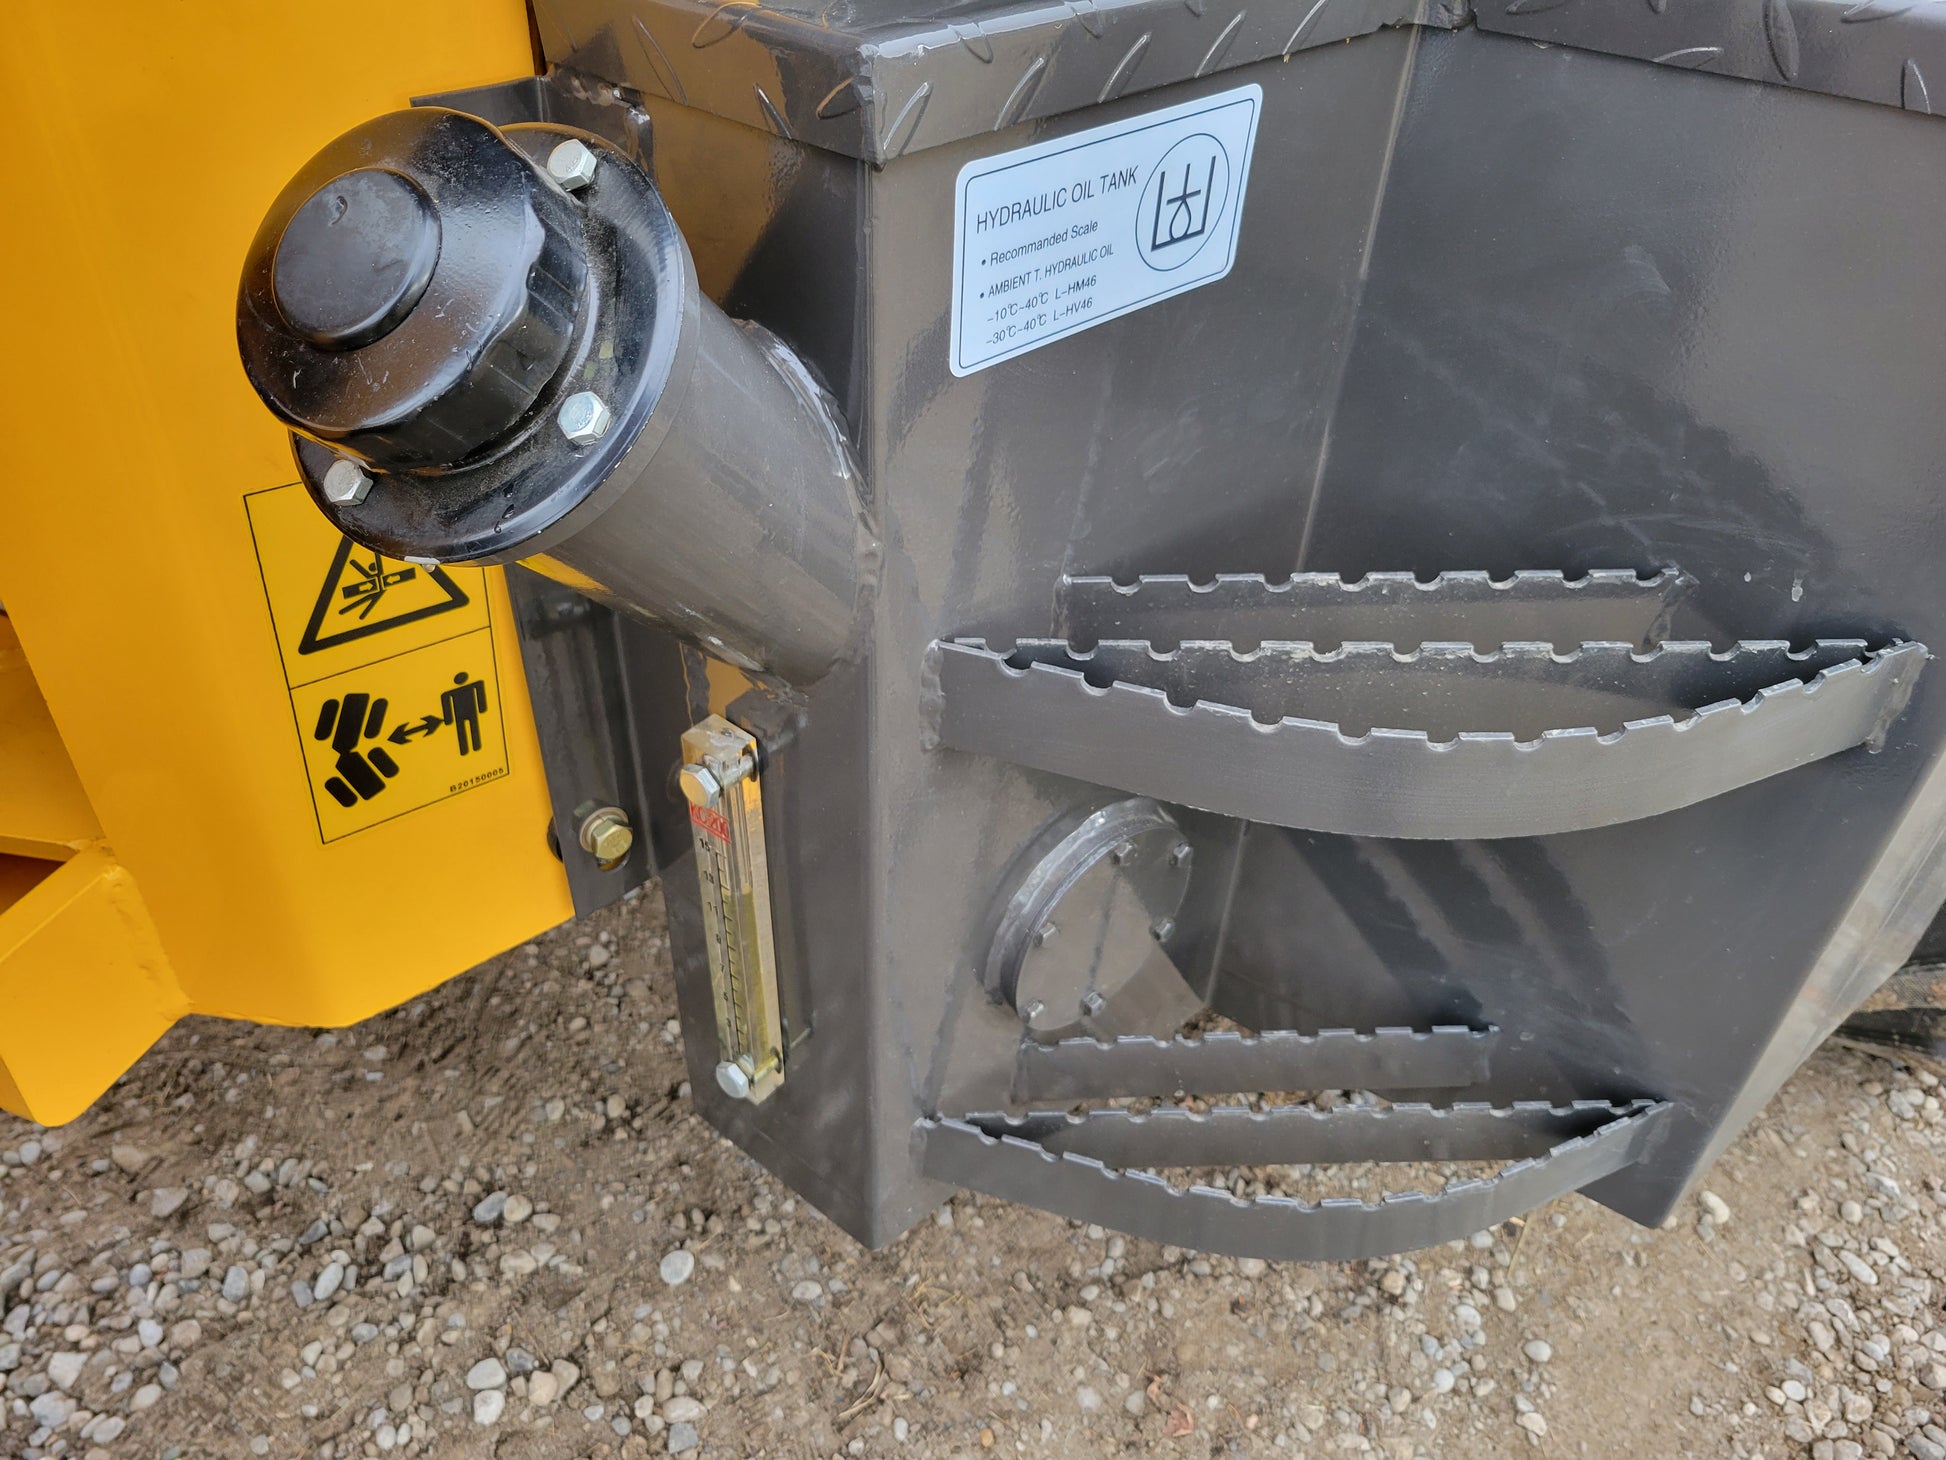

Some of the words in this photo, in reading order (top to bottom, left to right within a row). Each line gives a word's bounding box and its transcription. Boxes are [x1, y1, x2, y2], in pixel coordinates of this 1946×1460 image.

[977, 187, 1067, 233] HYDRAULIC
[1071, 180, 1095, 203] OIL
[1100, 165, 1139, 195] TANK
[990, 229, 1068, 266] Recommanded
[1071, 220, 1098, 239] Scale
[988, 271, 1032, 298] AMBIENT
[1035, 268, 1042, 282] T.
[1044, 248, 1098, 279] HYDRAULIC
[1099, 243, 1114, 259] OIL
[1055, 274, 1097, 300] L-HM46
[1053, 297, 1093, 321] L-HV46
[450, 768, 504, 792] B20150005
